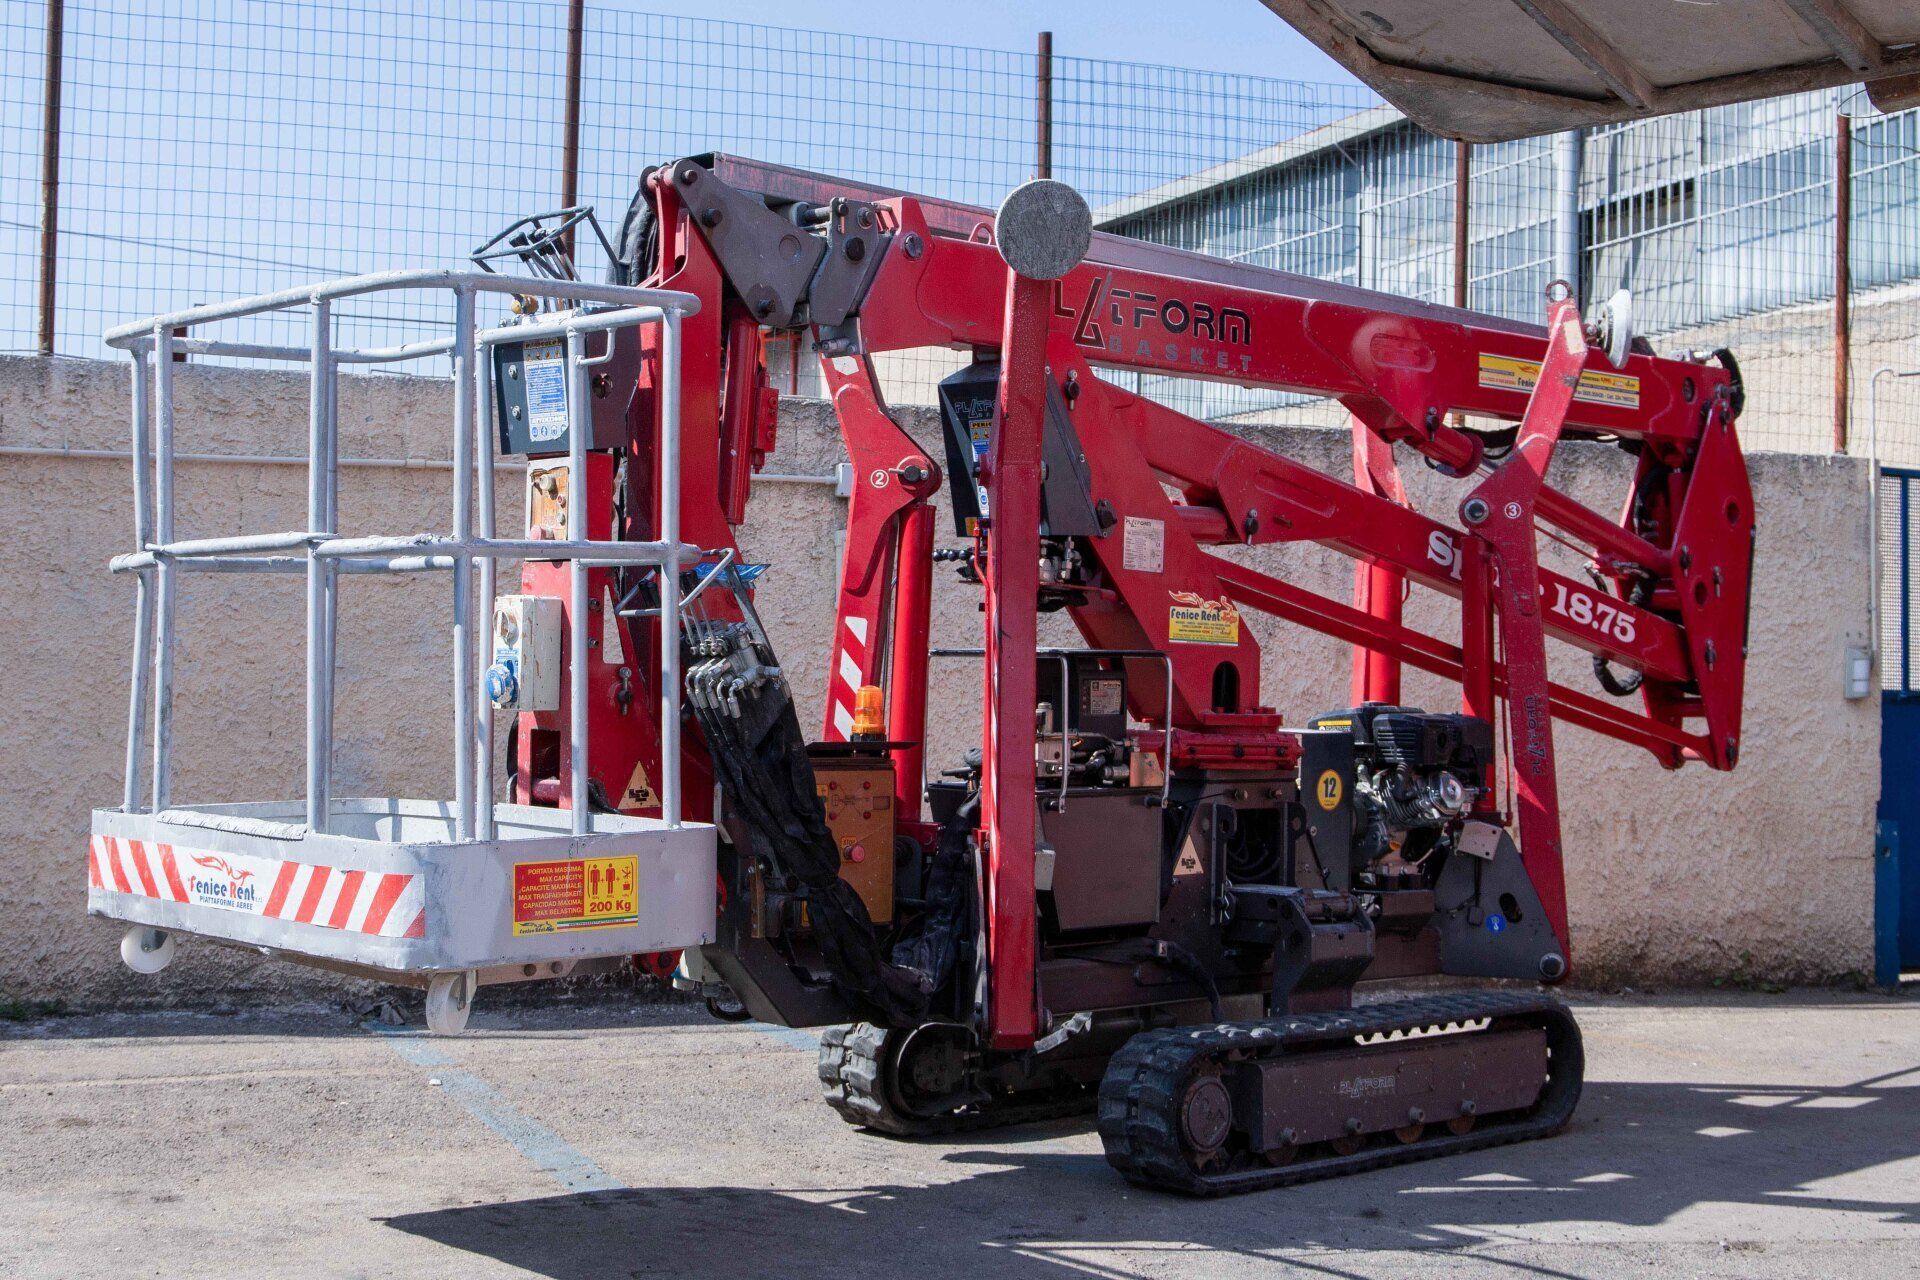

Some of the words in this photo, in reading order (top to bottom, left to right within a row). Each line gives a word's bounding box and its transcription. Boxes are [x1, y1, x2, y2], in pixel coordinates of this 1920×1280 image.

[1054, 271, 1251, 350] LATFORM
[1108, 335, 1252, 372] BASKET
[1518, 377, 1536, 388] Fenic
[955, 398, 995, 419] PLATF
[875, 472, 885, 485] 2
[1508, 504, 1518, 518] 3
[1550, 582, 1636, 644] 18.75
[1324, 777, 1337, 798] 12
[528, 867, 554, 876] PORTATA
[522, 901, 557, 909] CAPACIDAD
[589, 901, 613, 913] 200
[615, 899, 632, 912] Kg
[534, 909, 548, 917] MAX
